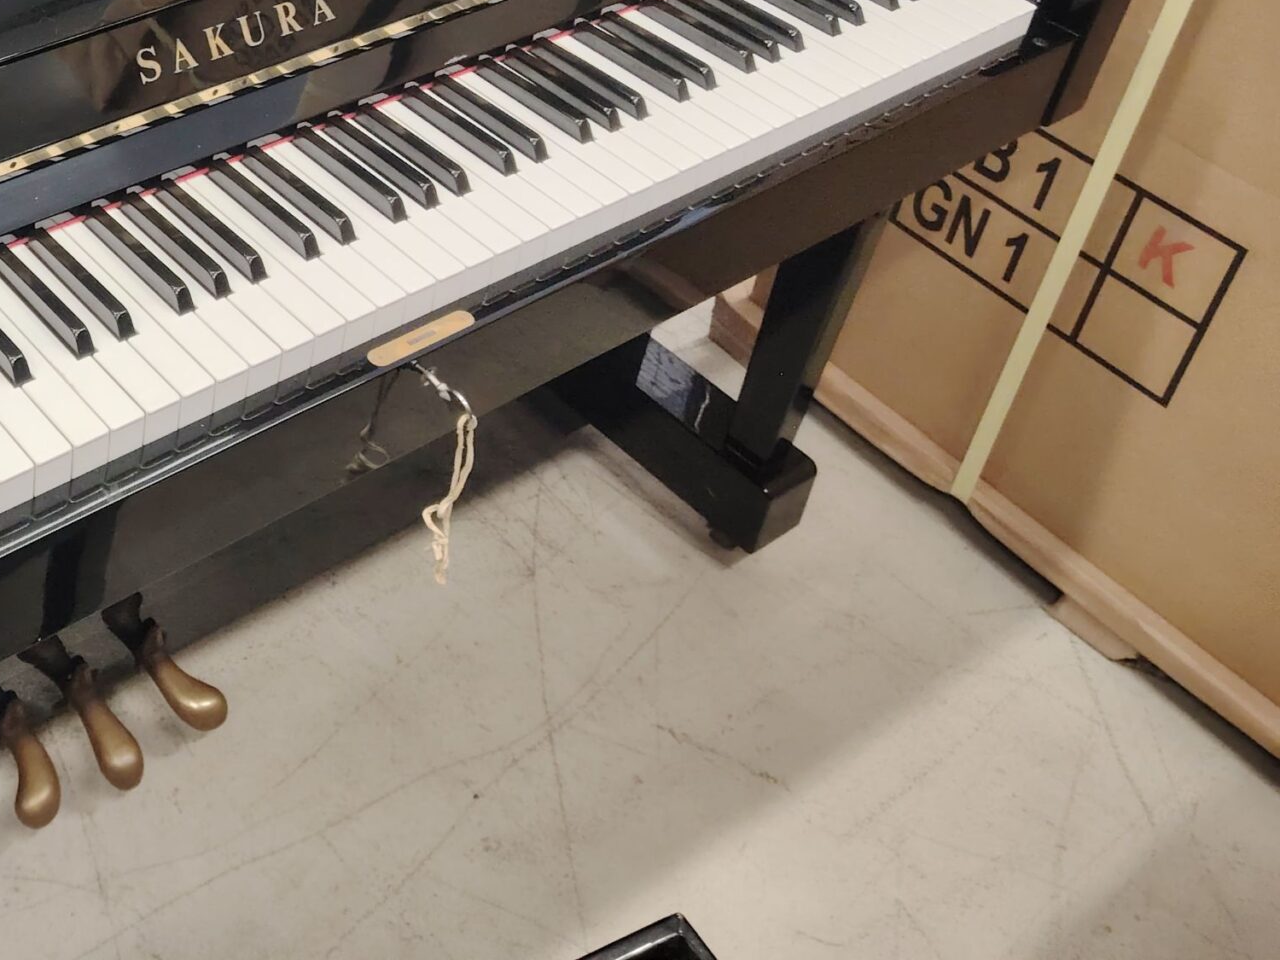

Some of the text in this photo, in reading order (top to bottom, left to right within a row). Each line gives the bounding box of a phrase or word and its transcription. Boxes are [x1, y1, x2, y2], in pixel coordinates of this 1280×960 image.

[1033, 157, 1062, 211] 1
[912, 179, 1029, 283] GN 1
[1137, 225, 1196, 289] K
